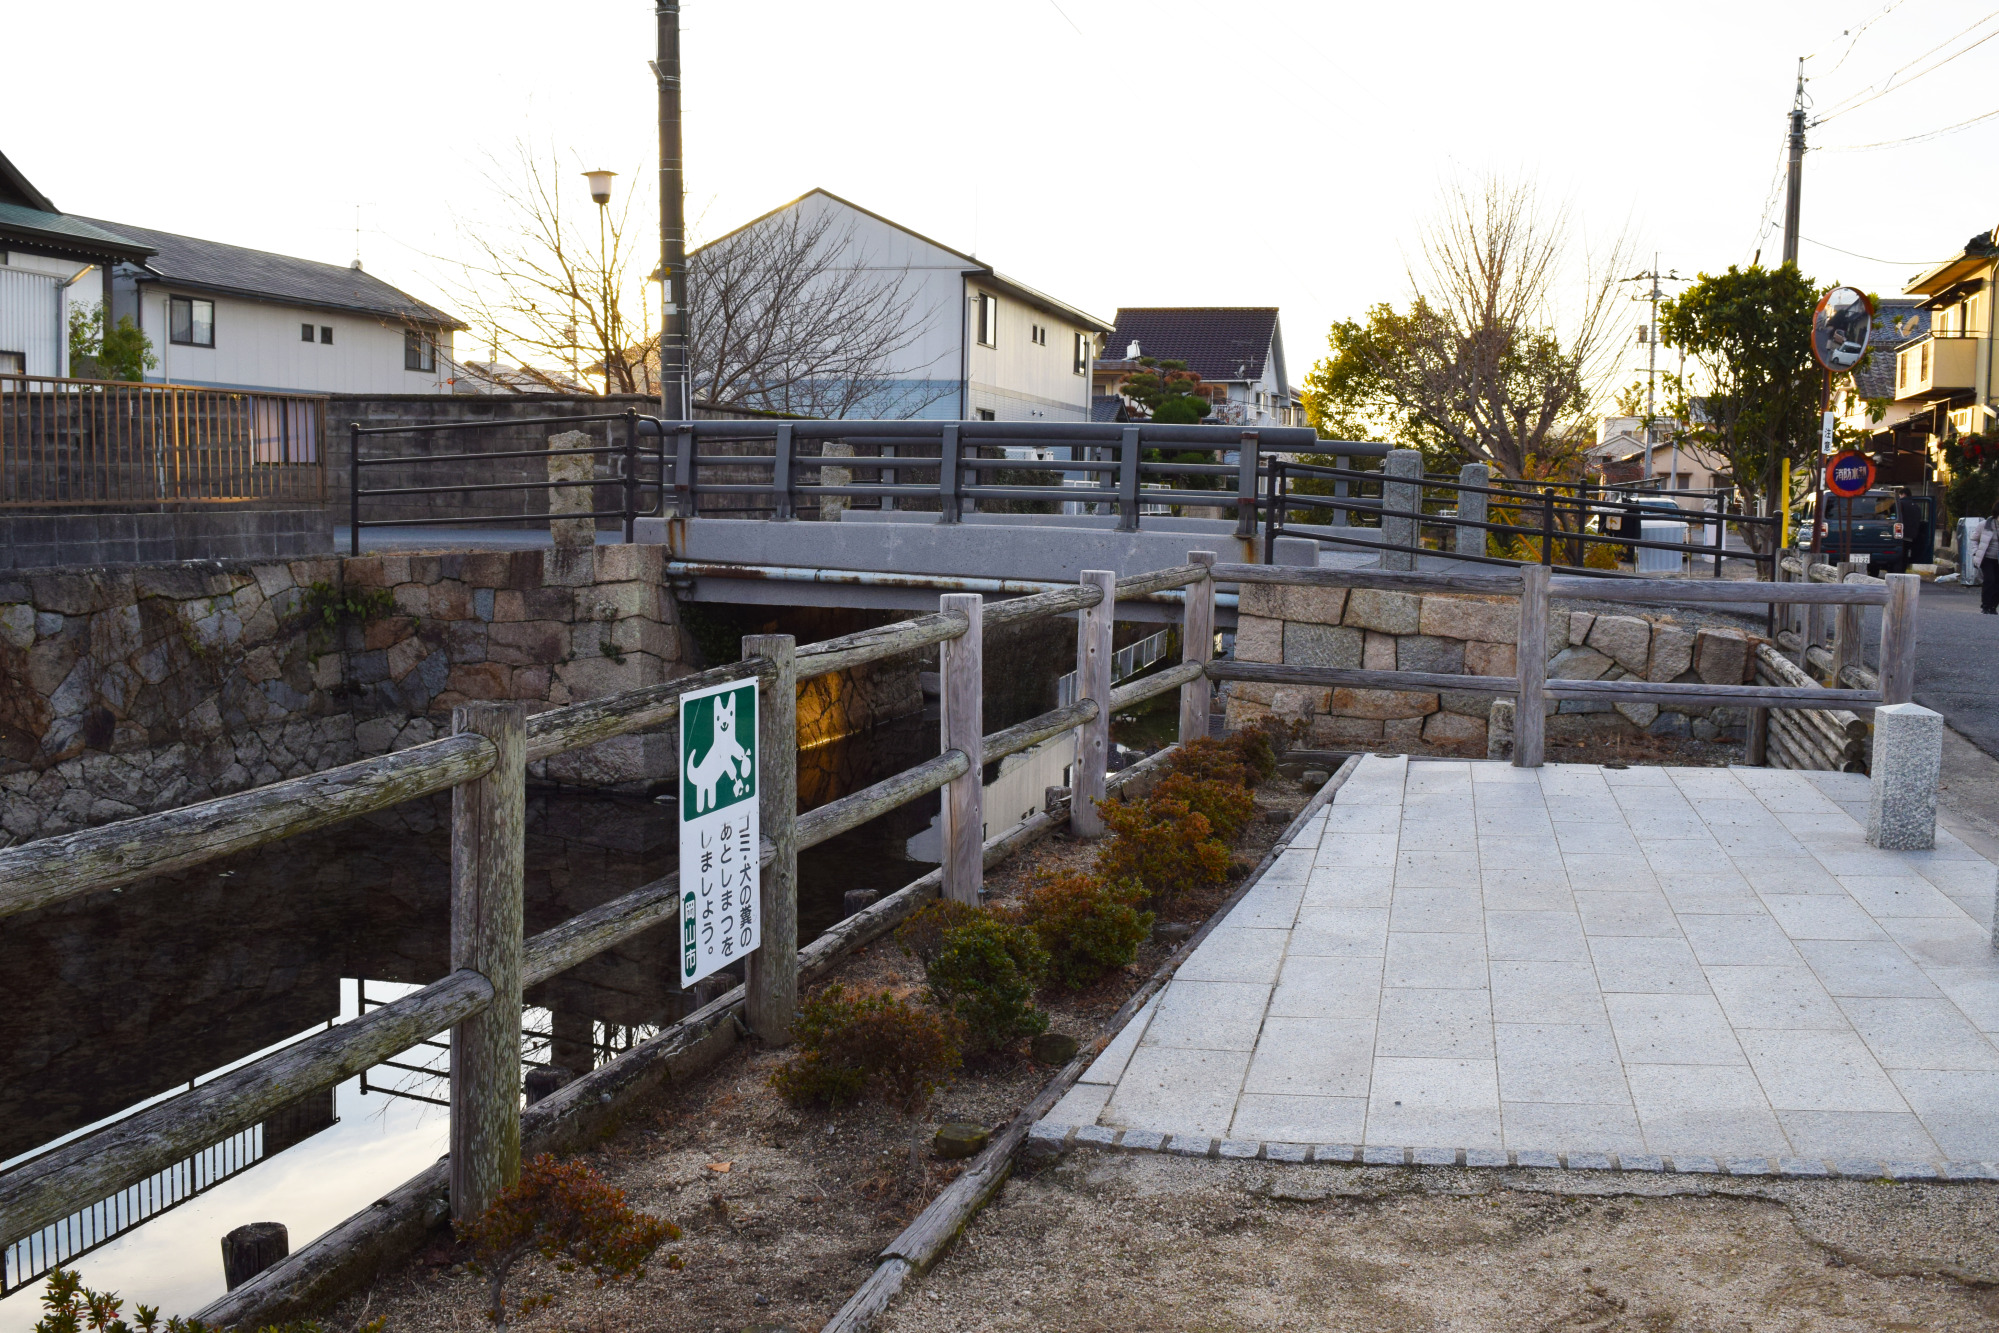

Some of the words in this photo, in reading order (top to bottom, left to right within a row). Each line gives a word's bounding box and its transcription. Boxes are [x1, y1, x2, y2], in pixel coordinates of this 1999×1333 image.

[1823, 428, 1831, 451] 注意
[1835, 466, 1867, 481] 消防水利
[701, 829, 714, 955] しましょう。
[720, 822, 734, 957] あとしまつを
[685, 899, 696, 970] 岡山市
